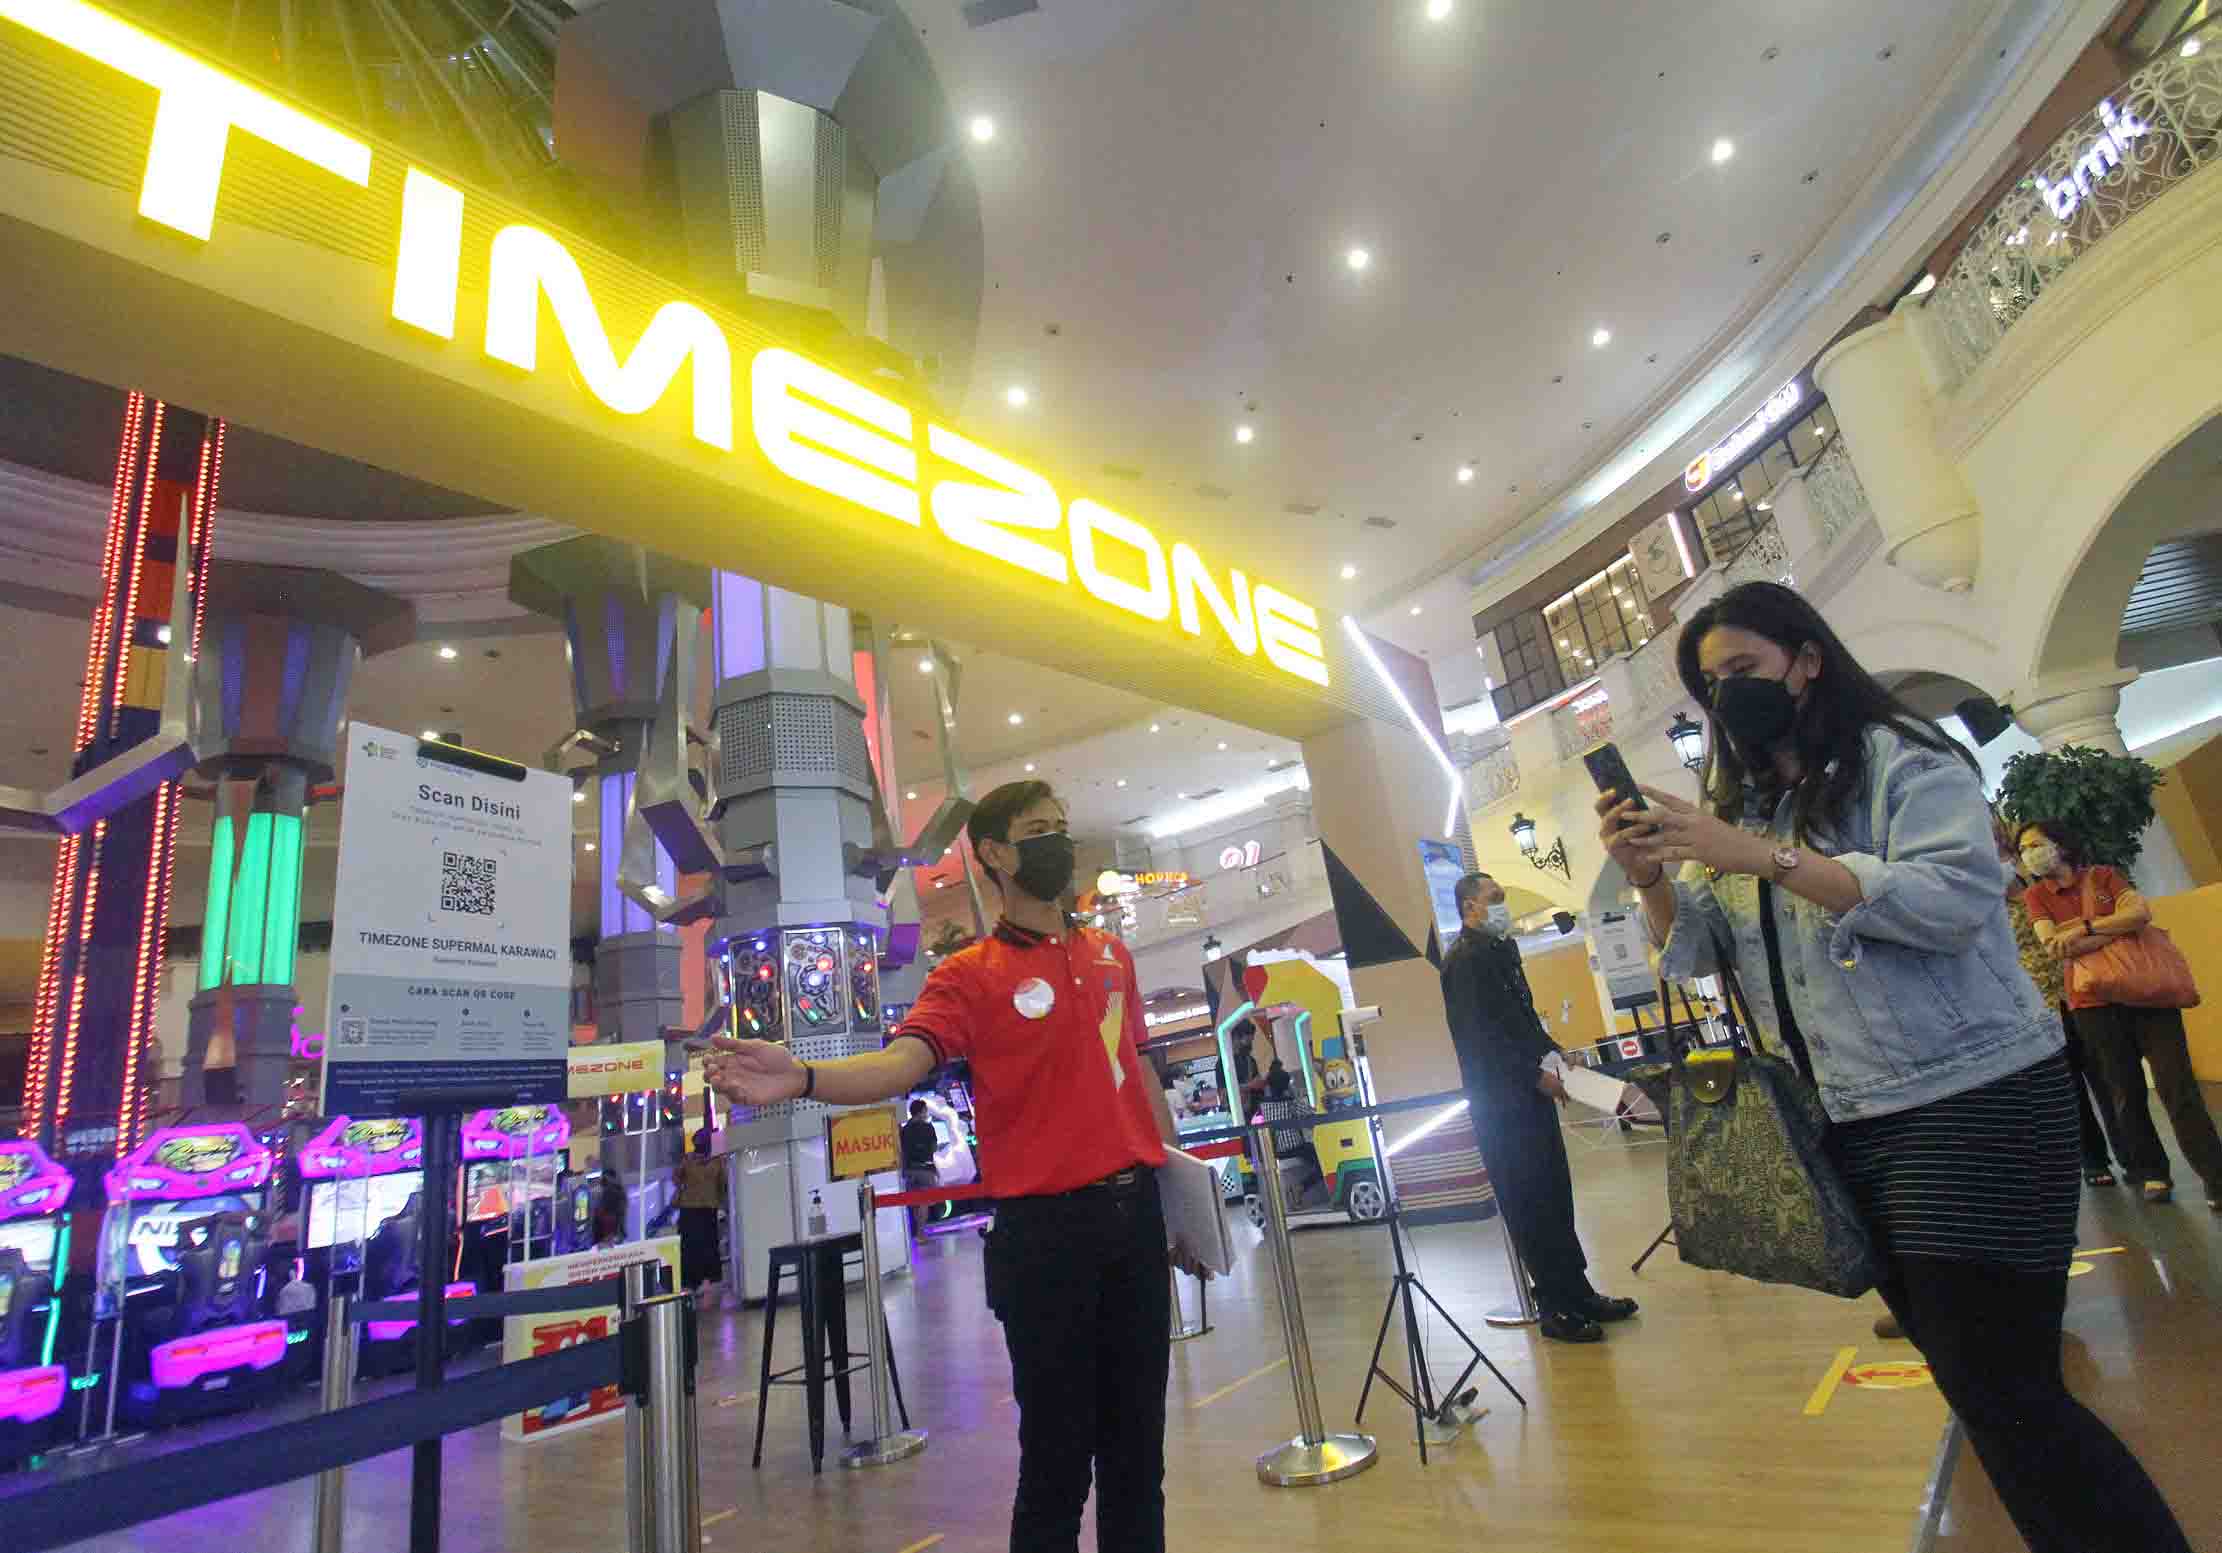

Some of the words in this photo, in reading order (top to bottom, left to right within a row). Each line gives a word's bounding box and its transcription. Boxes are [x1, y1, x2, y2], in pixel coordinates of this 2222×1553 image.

[0, 0, 1330, 688] TIMEZONE
[418, 783, 465, 809] Scan
[471, 795, 521, 821] Disini
[359, 931, 428, 949] TIMEZONE
[431, 938, 498, 955] SUPERMAL
[500, 944, 557, 961] KARAWACI
[835, 1135, 897, 1154] MASUK
